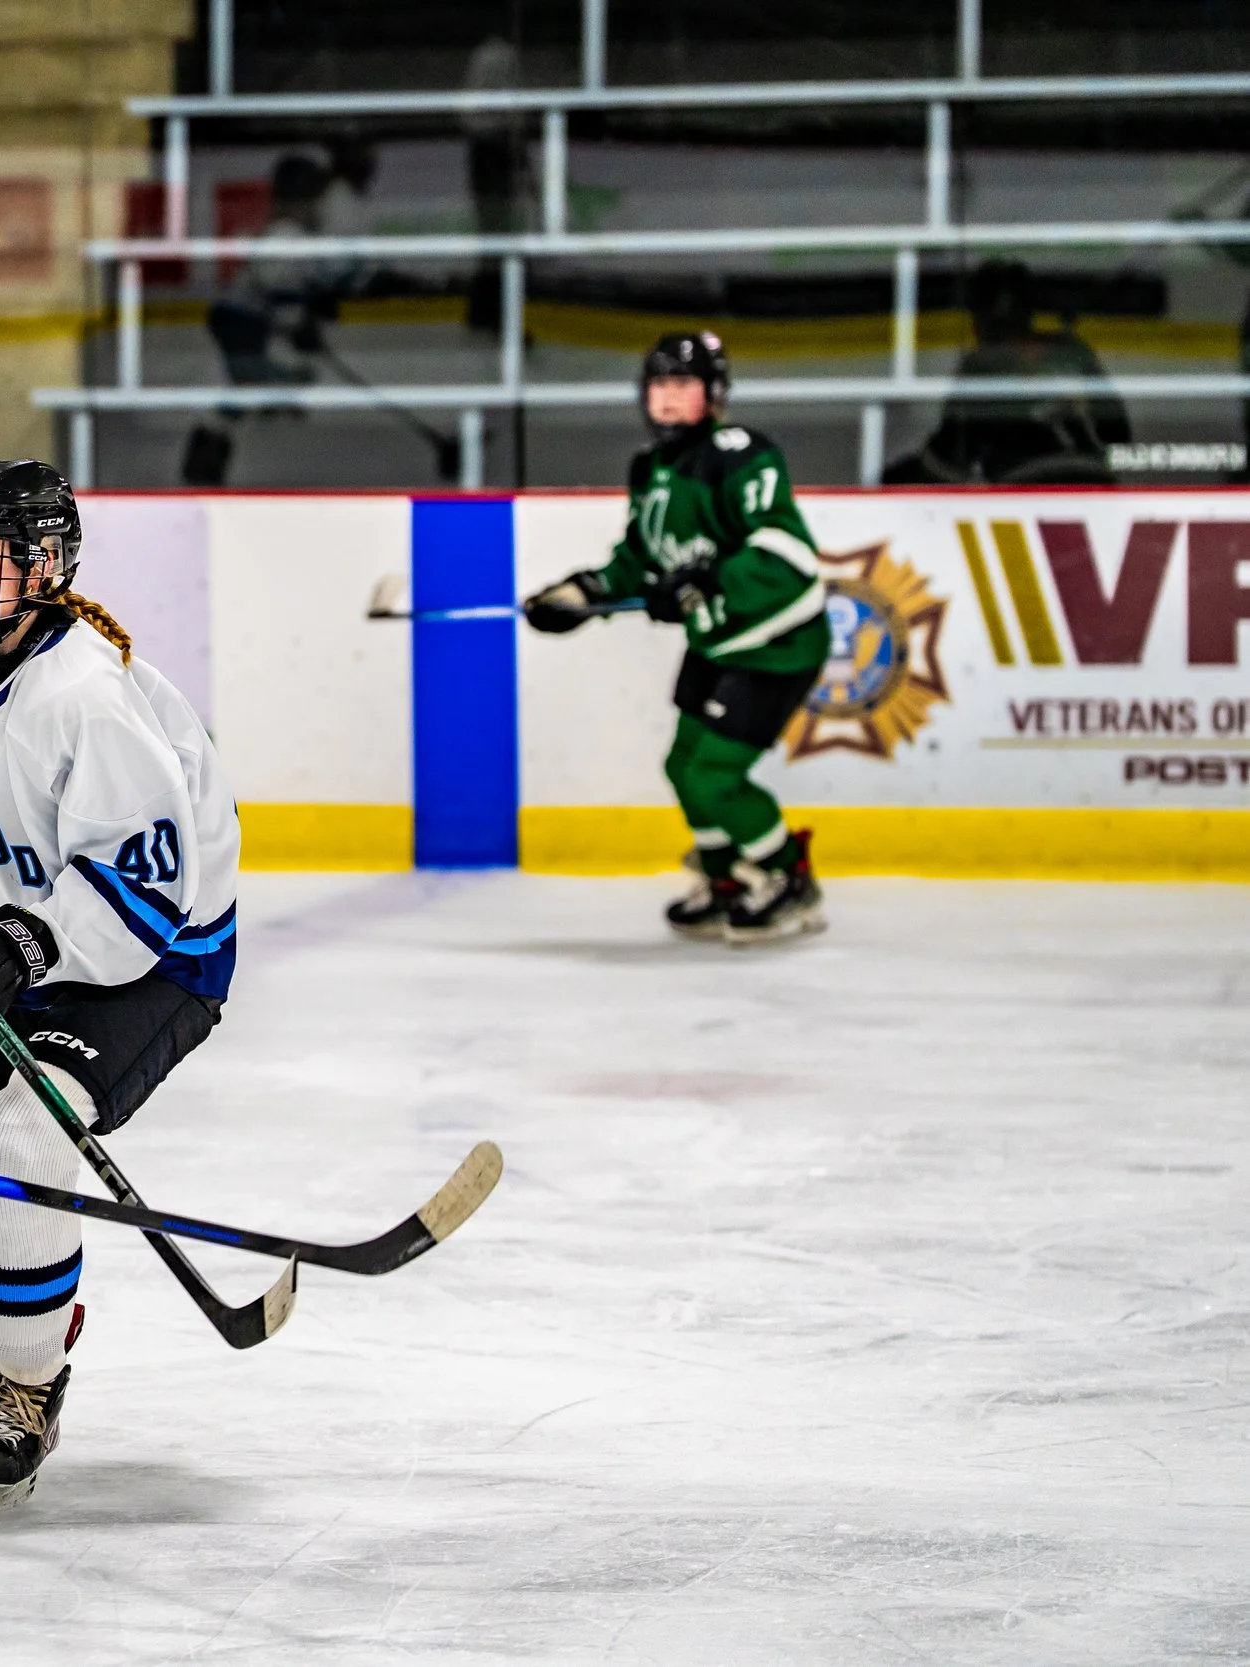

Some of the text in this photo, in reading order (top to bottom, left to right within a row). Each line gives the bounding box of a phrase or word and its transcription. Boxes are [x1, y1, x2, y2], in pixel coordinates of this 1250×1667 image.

[37, 516, 65, 528] CCM
[28, 554, 48, 562] CCM
[1037, 520, 1250, 665] VF
[1009, 698, 1197, 733] VETERANS
[114, 817, 181, 884] 40
[29, 1031, 100, 1060] CCM
